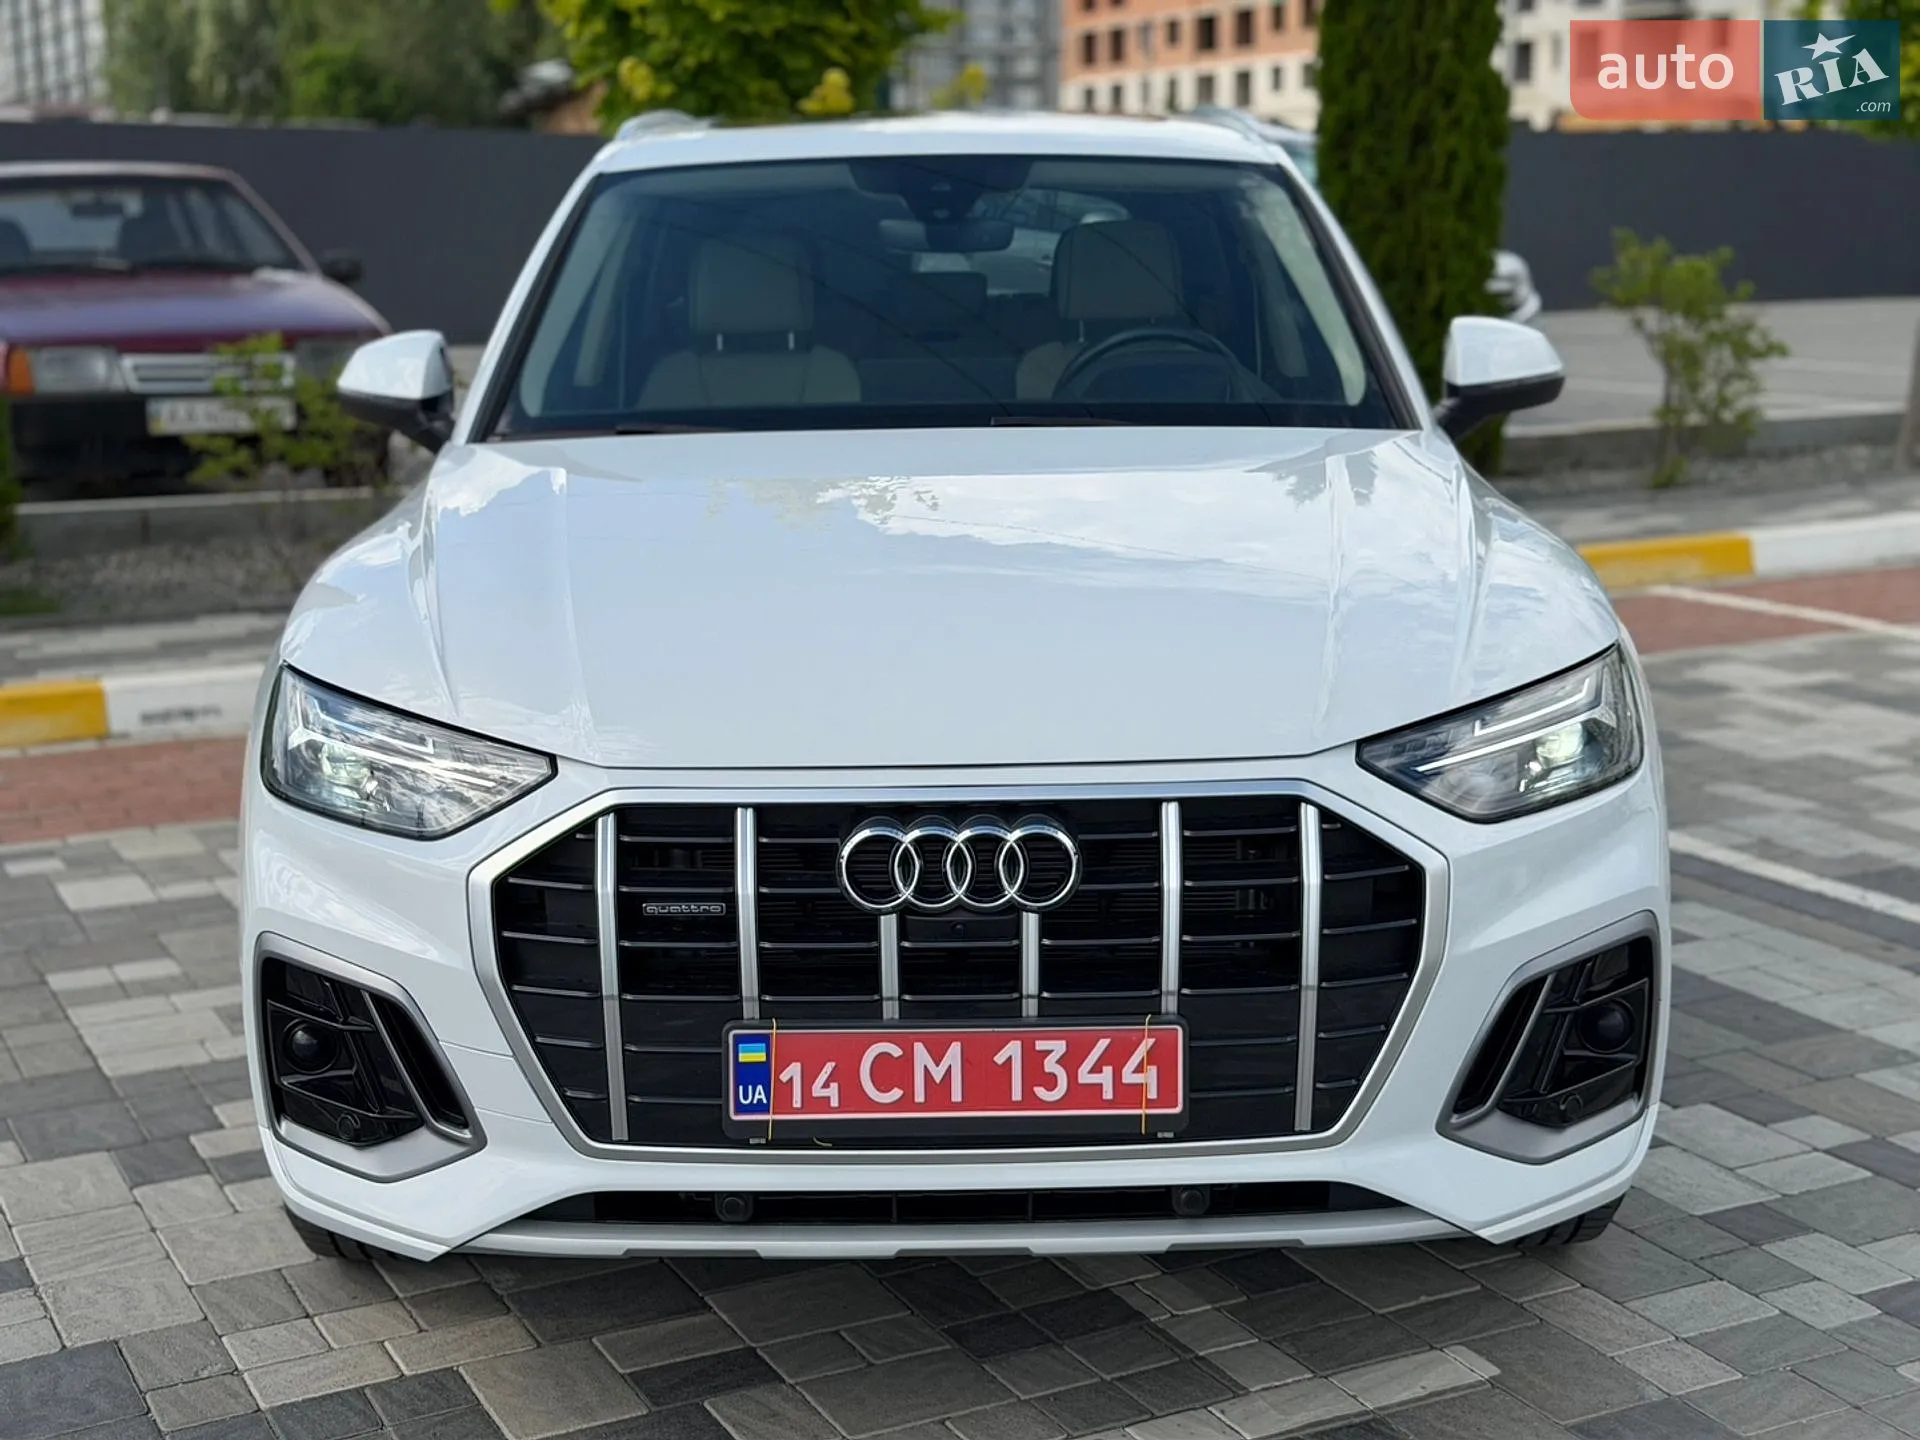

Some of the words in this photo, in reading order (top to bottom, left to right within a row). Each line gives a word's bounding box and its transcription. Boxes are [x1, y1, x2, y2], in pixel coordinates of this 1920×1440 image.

[646, 905, 721, 915] quattro
[778, 1061, 840, 1108] 14
[858, 1040, 963, 1104] CM
[992, 1038, 1159, 1101] 1344
[738, 1086, 767, 1104] UA
